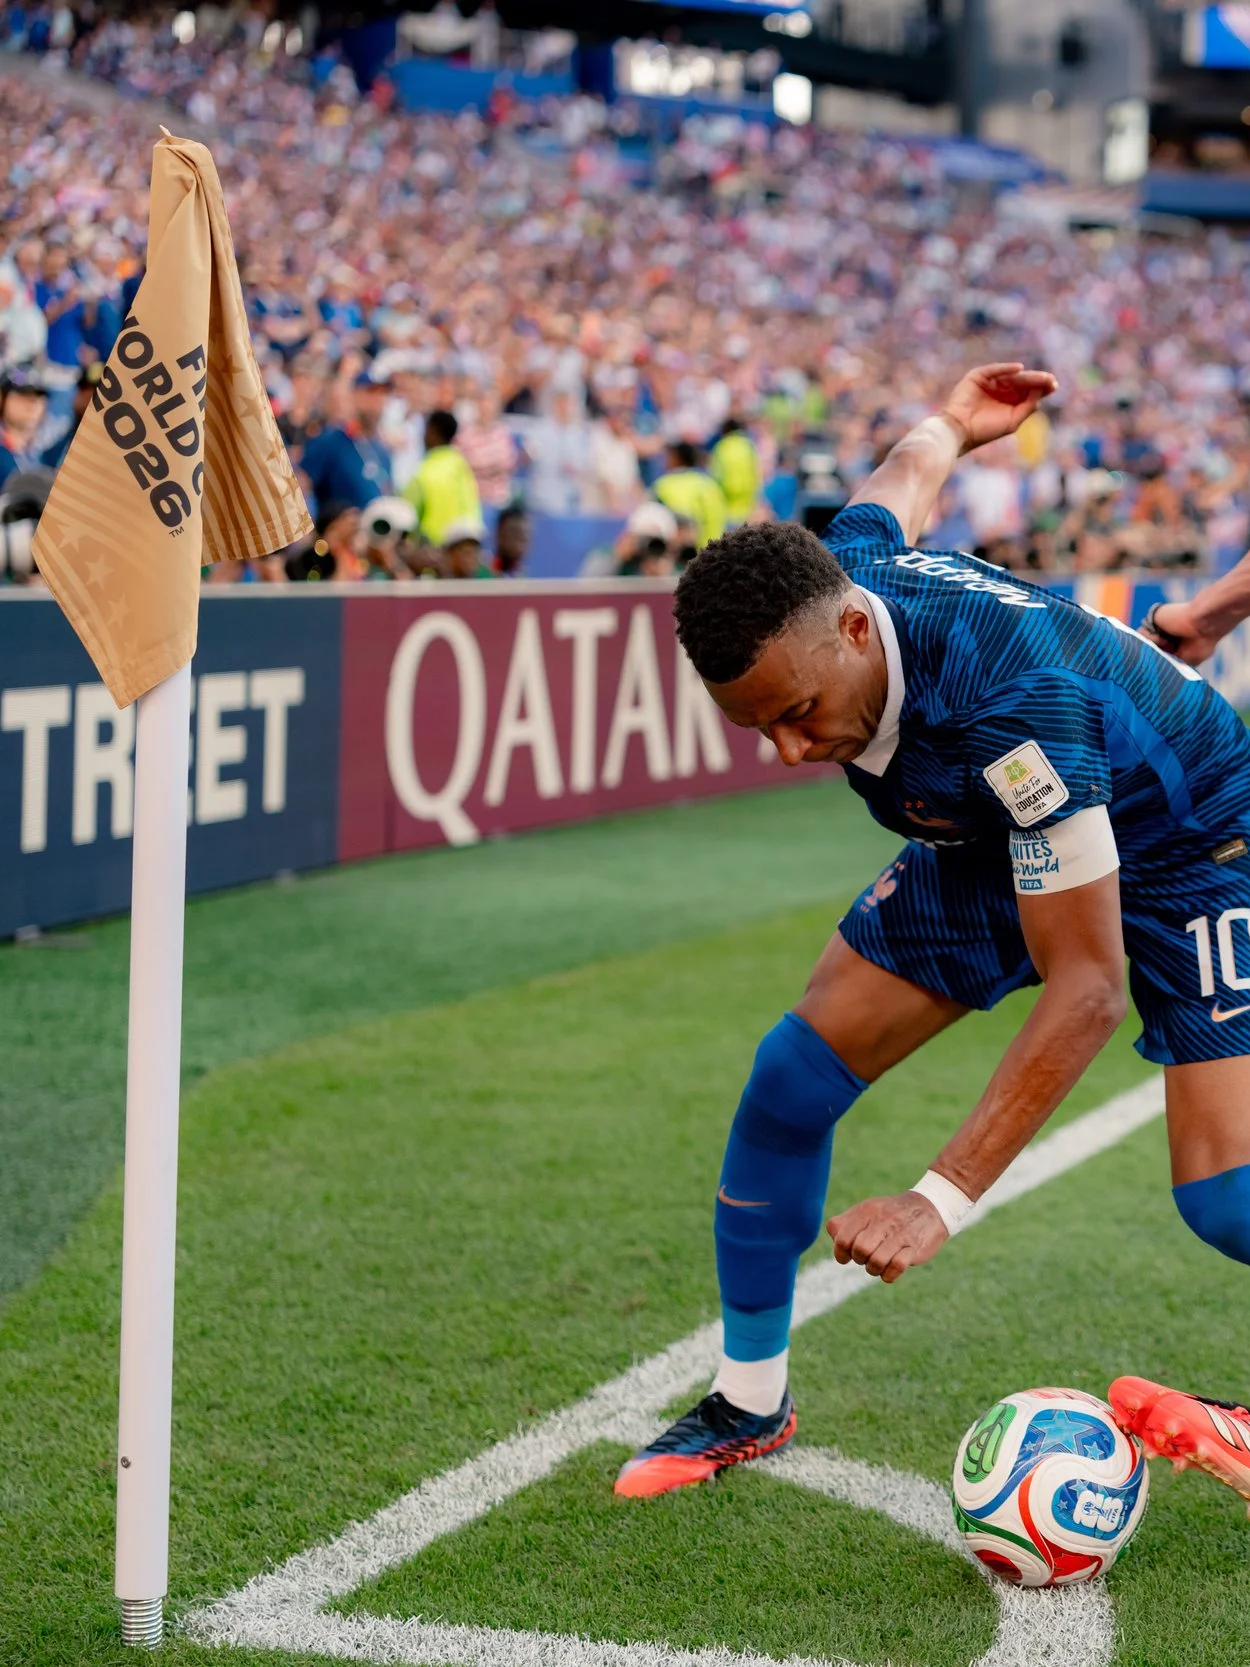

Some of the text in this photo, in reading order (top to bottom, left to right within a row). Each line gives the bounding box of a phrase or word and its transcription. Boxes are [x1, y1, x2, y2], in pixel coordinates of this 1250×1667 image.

[121, 315, 200, 457] ORLD
[92, 365, 192, 528] 2026
[886, 551, 1048, 609] MBAPP
[1, 667, 305, 854] TRET
[1012, 775, 1041, 800] Unite For
[1015, 782, 1055, 812] EDUCATION
[1032, 801, 1047, 813] FIFA
[1011, 840, 1053, 860] NITES
[1020, 857, 1060, 876] World
[1020, 880, 1042, 890] FIFA
[1110, 1508, 1119, 1524] FIFA
